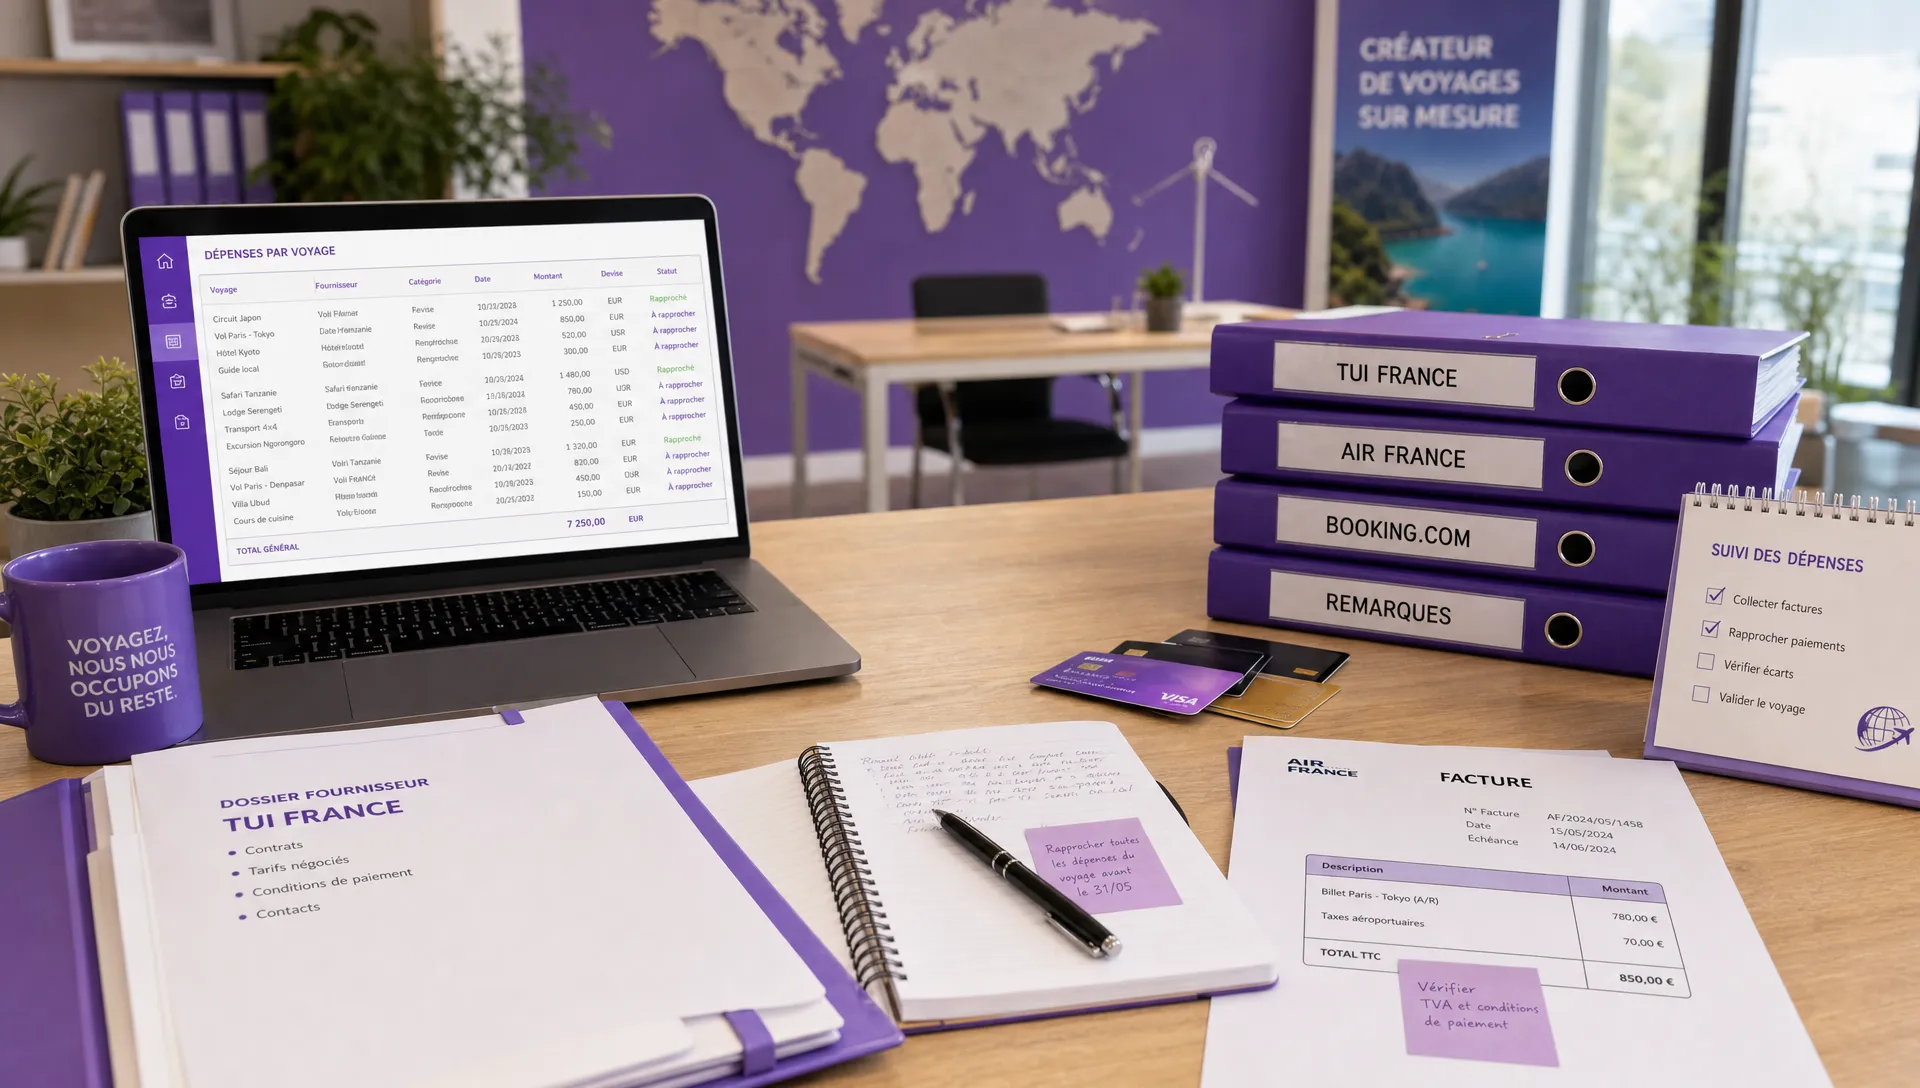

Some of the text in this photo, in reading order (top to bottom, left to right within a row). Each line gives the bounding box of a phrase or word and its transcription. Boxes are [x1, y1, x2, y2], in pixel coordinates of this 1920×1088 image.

[1360, 31, 1493, 61] CRÉATEUR
[1359, 69, 1521, 95] DE VOYAGES
[1358, 104, 1520, 129] SUR MESURE
[204, 246, 336, 260] DÉPENSES PAR VOYAGE
[534, 272, 563, 280] Montant
[657, 267, 677, 275] Statut
[408, 277, 441, 287] Catégorie
[475, 275, 491, 283] Date
[210, 286, 237, 294] Voyage
[315, 281, 358, 290] Fournisseur
[558, 299, 583, 307] 250,00
[608, 297, 622, 305] EUR
[650, 294, 687, 303] Rapproché
[213, 314, 262, 323] Circuit Japon
[560, 315, 585, 323] 850,00
[609, 313, 624, 321] EUR
[658, 310, 696, 319] rapprocher
[215, 330, 275, 340] Vol Paris Tokyo
[561, 331, 587, 339] 520,00
[217, 348, 260, 357] Hôtel Kyoto
[563, 347, 588, 355] 300,00
[218, 365, 259, 374] Guide local
[615, 368, 629, 376] USD
[657, 364, 695, 373] Rapproché
[565, 370, 591, 379] 480,00
[1337, 363, 1457, 387] TUI FRANCE
[221, 389, 277, 399] Safari Tanzanie
[223, 406, 282, 417] Lodge Serengeti
[569, 402, 594, 411] 450,00
[570, 418, 596, 427] 250,00
[225, 423, 277, 434] Transport 4x4
[226, 439, 305, 450] Excursion Ngorongoro
[572, 441, 597, 450] 320,00
[621, 439, 636, 447] EUR
[672, 450, 710, 459] rapprocher
[1341, 442, 1466, 468] AIR FRANCE
[574, 458, 599, 466] 820,00
[229, 465, 268, 475] Séjour Bali
[576, 473, 600, 482] 450,00
[245, 482, 263, 490] Paris
[270, 480, 305, 490] Denpasar
[577, 489, 602, 498] 150,00
[232, 499, 270, 508] Villa Ubud
[234, 514, 294, 525] Cours de cuisine
[575, 517, 606, 528] 250,00
[629, 514, 644, 523] EUR
[1326, 516, 1470, 547] BOOKING.COM
[236, 543, 299, 555] TOTAL GÉNÉRAL
[1712, 543, 1864, 573] SUIVI DES DÉPENSES
[1326, 593, 1451, 625] REMARQUES
[1733, 594, 1823, 615] Collecter factures
[67, 625, 168, 655] VOYAGEZ,
[1729, 627, 1845, 652] Rapprocher paiements
[69, 643, 176, 676] NOUS NOUS
[1724, 659, 1794, 679] Vérifier écarts
[70, 663, 178, 697] OCCUPONS
[84, 685, 177, 718] DU RESTE.
[1161, 692, 1198, 706] VISA
[1719, 692, 1806, 716] Valider le voyage
[1288, 758, 1324, 767] AIR
[1288, 766, 1358, 778] FRANCE
[1441, 772, 1533, 788] FACTURE
[220, 778, 429, 809] DOSSIER FOURNISSEUR
[223, 800, 403, 832] TUI FRANCE
[1481, 808, 1520, 818] Facture
[1466, 821, 1491, 830] Date
[1547, 813, 1644, 829] AF/2024/05/1458
[1550, 827, 1613, 840] 15/05/2024
[245, 840, 303, 855] Contrats
[1045, 837, 1140, 854] Rapprocher toutes
[1553, 842, 1617, 854] 14/06/2024
[1051, 860, 1066, 868] les
[1122, 851, 1135, 860] du
[248, 855, 350, 876] Tarifs négociés
[1322, 862, 1384, 875] Description
[1059, 866, 1132, 884] voyage avant
[252, 867, 413, 897] Conditions de paiement
[1077, 881, 1132, 896] le 31/05
[1602, 885, 1649, 896] Montant
[1321, 887, 1346, 897] Billet
[1348, 890, 1373, 900] Paris
[1382, 892, 1411, 904] Tokyo
[1413, 895, 1439, 906] (A/R)
[256, 902, 321, 919] Contacts
[1321, 912, 1425, 928] Taxes aéroportuaires
[1612, 913, 1658, 924] 780,00 €
[1623, 937, 1664, 948] 70,00 €
[1320, 948, 1381, 961] TOTAL TTC
[1619, 973, 1674, 986] 850,00 €
[1418, 981, 1476, 995] Vérifier
[1420, 999, 1539, 1013] TVA et conditions
[1425, 1015, 1508, 1030] de paiement
